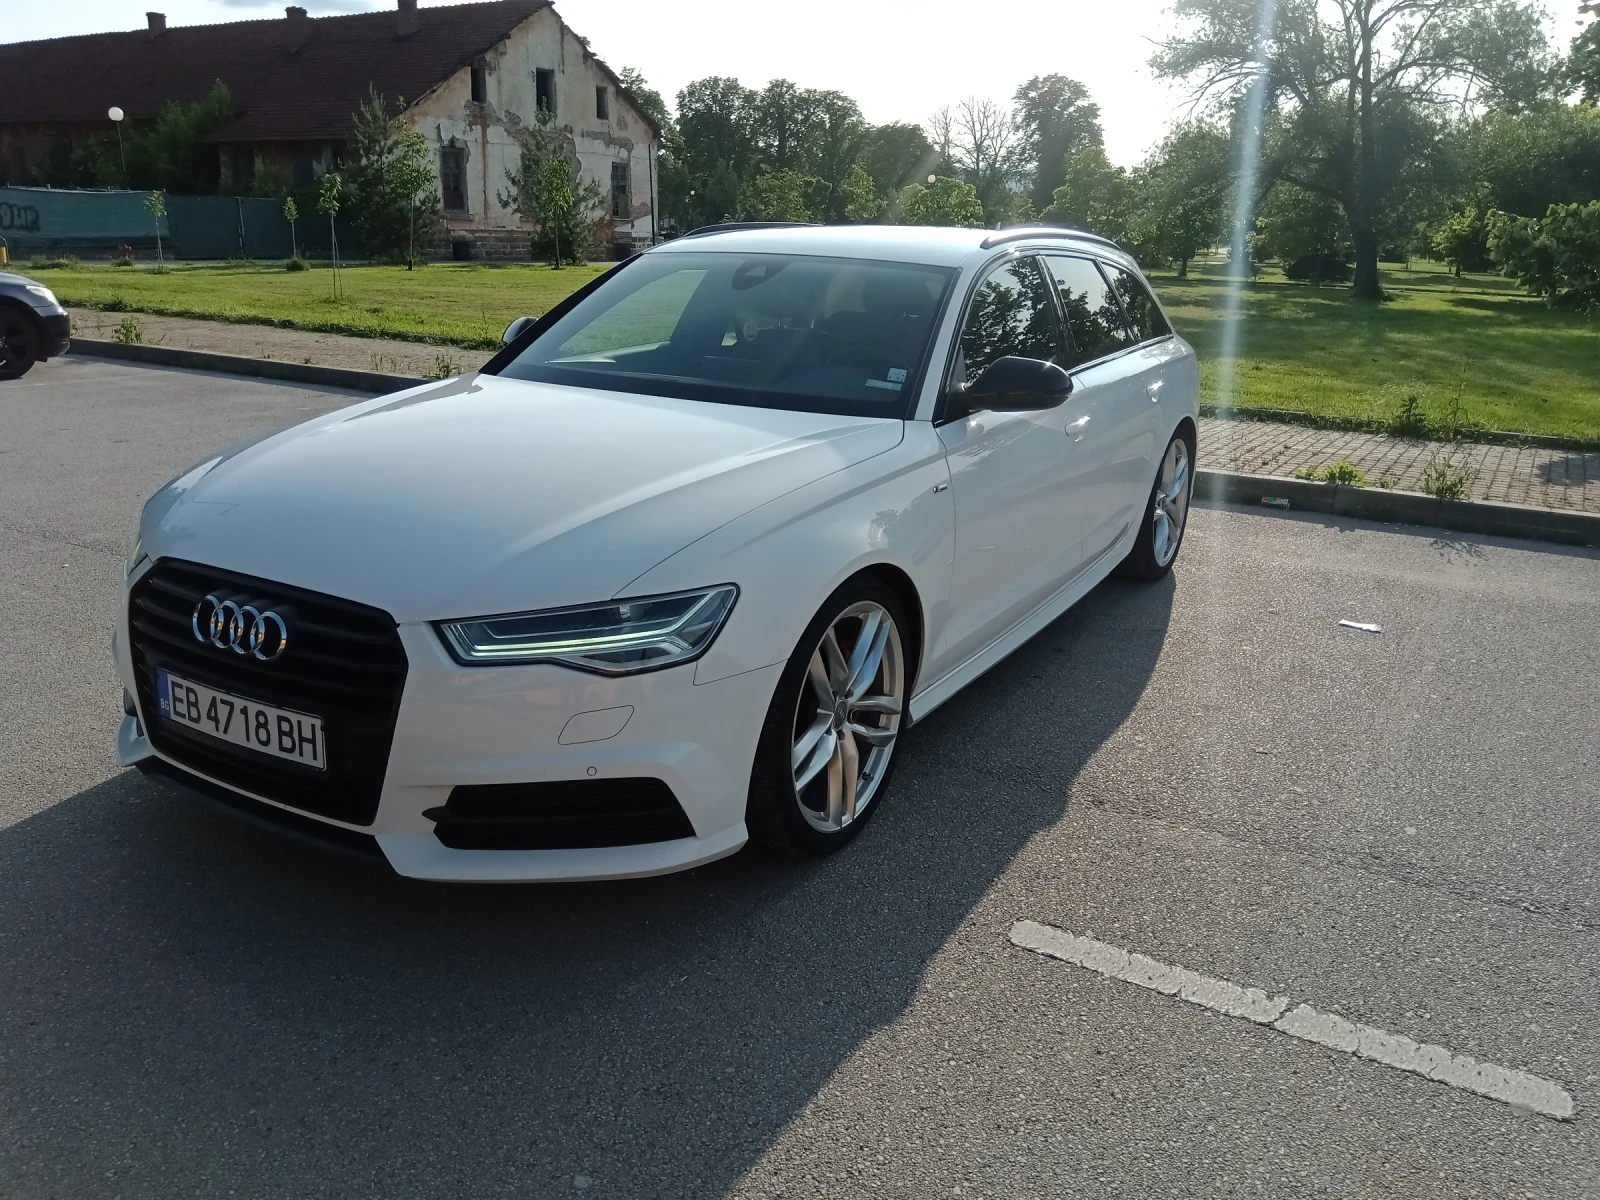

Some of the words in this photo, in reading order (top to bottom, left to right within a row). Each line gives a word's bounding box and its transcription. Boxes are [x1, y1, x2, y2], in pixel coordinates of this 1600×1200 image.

[160, 697, 170, 711] BG
[171, 680, 201, 724] EB
[206, 696, 271, 747] 4718
[276, 714, 318, 761] BH
